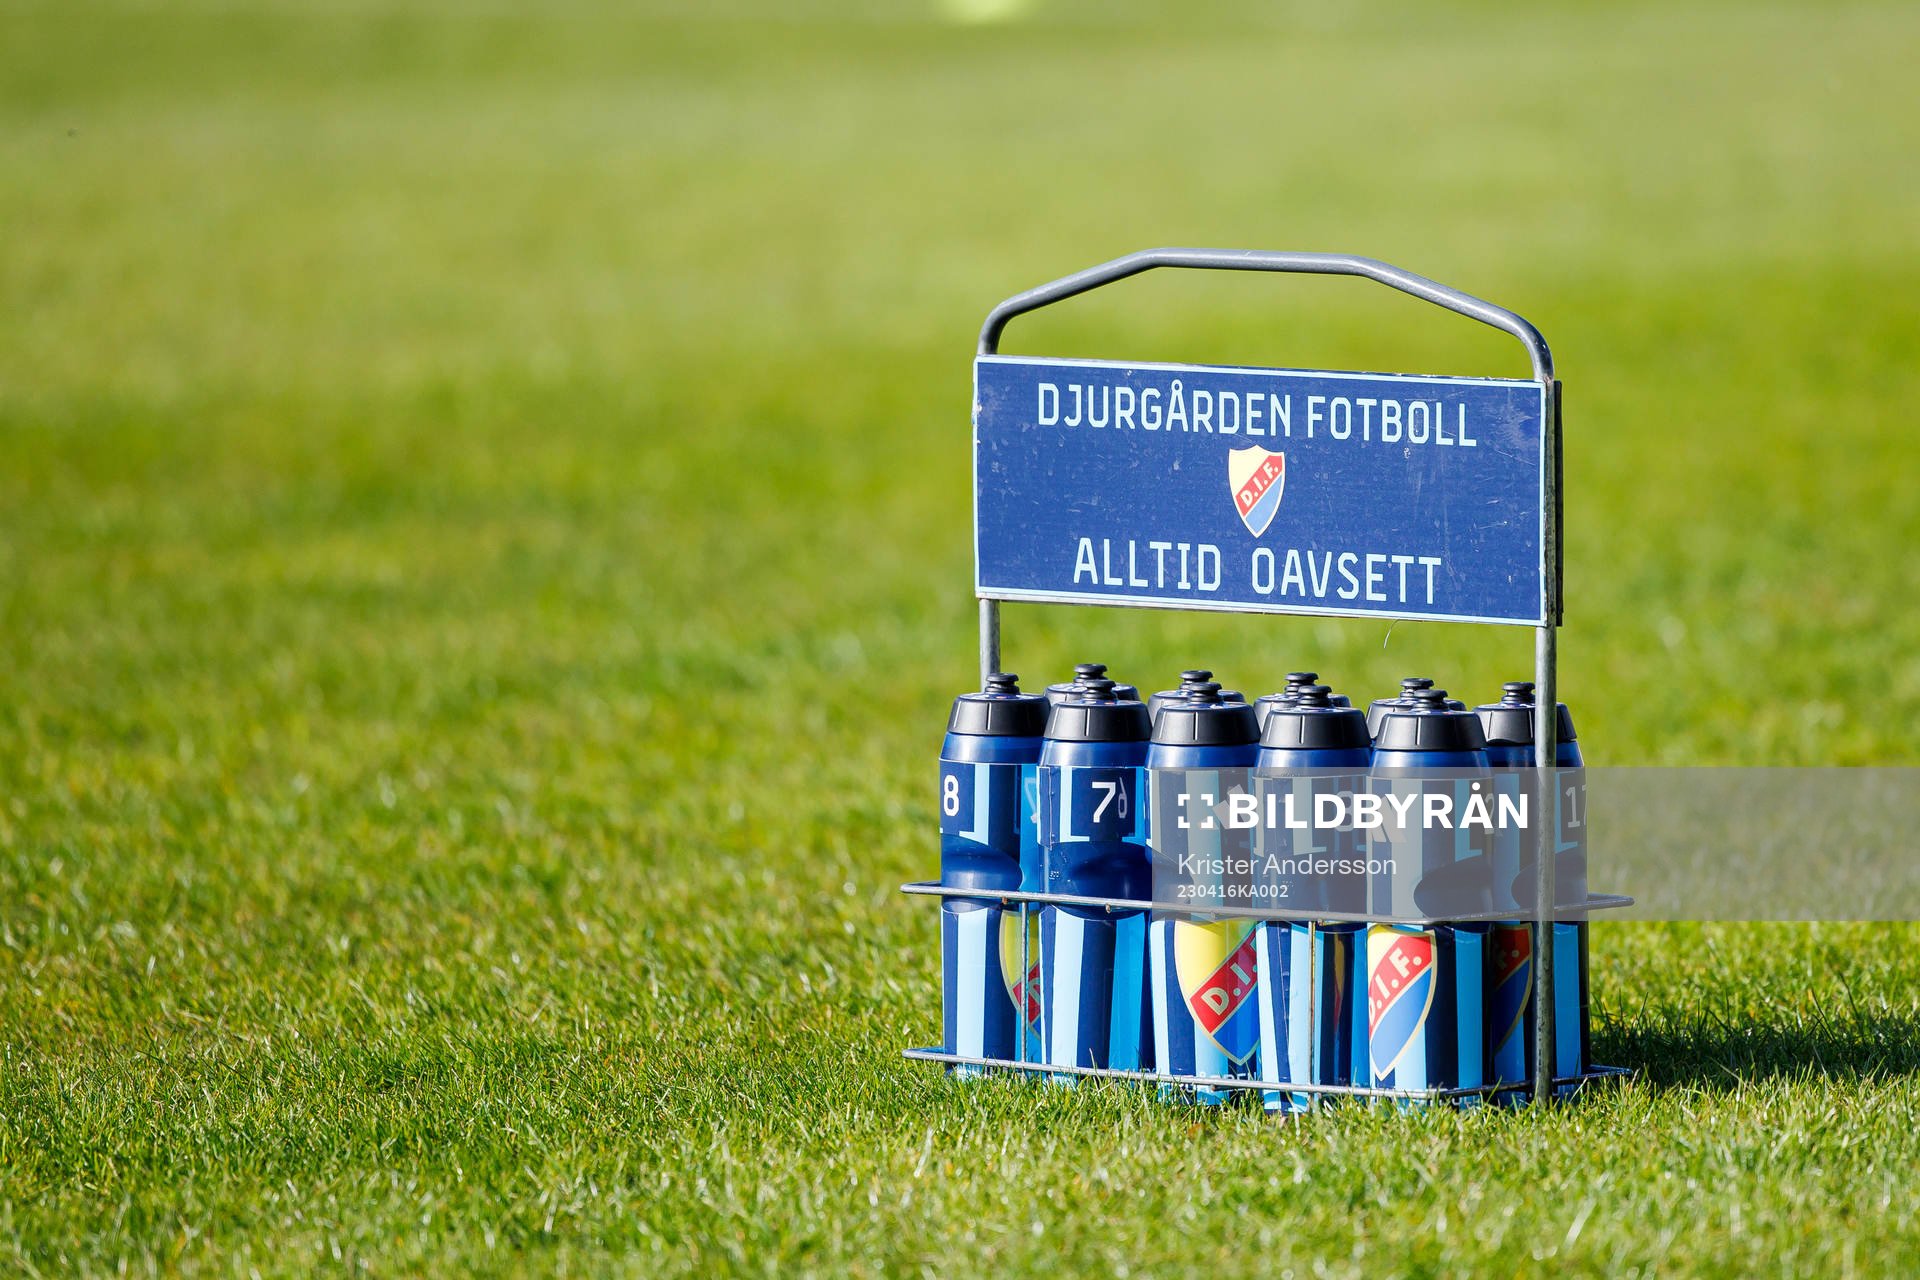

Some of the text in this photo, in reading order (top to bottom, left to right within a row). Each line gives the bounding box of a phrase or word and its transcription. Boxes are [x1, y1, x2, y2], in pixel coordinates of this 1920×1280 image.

[1038, 379, 1477, 447] DJURGÅRDEN FOTBOLL
[1240, 462, 1279, 507] D.I.F.
[1073, 537, 1442, 604] ALLTID OAVSETT
[943, 774, 960, 817] 8
[1092, 781, 1117, 823] 7
[1200, 936, 1258, 1016] D.I.
